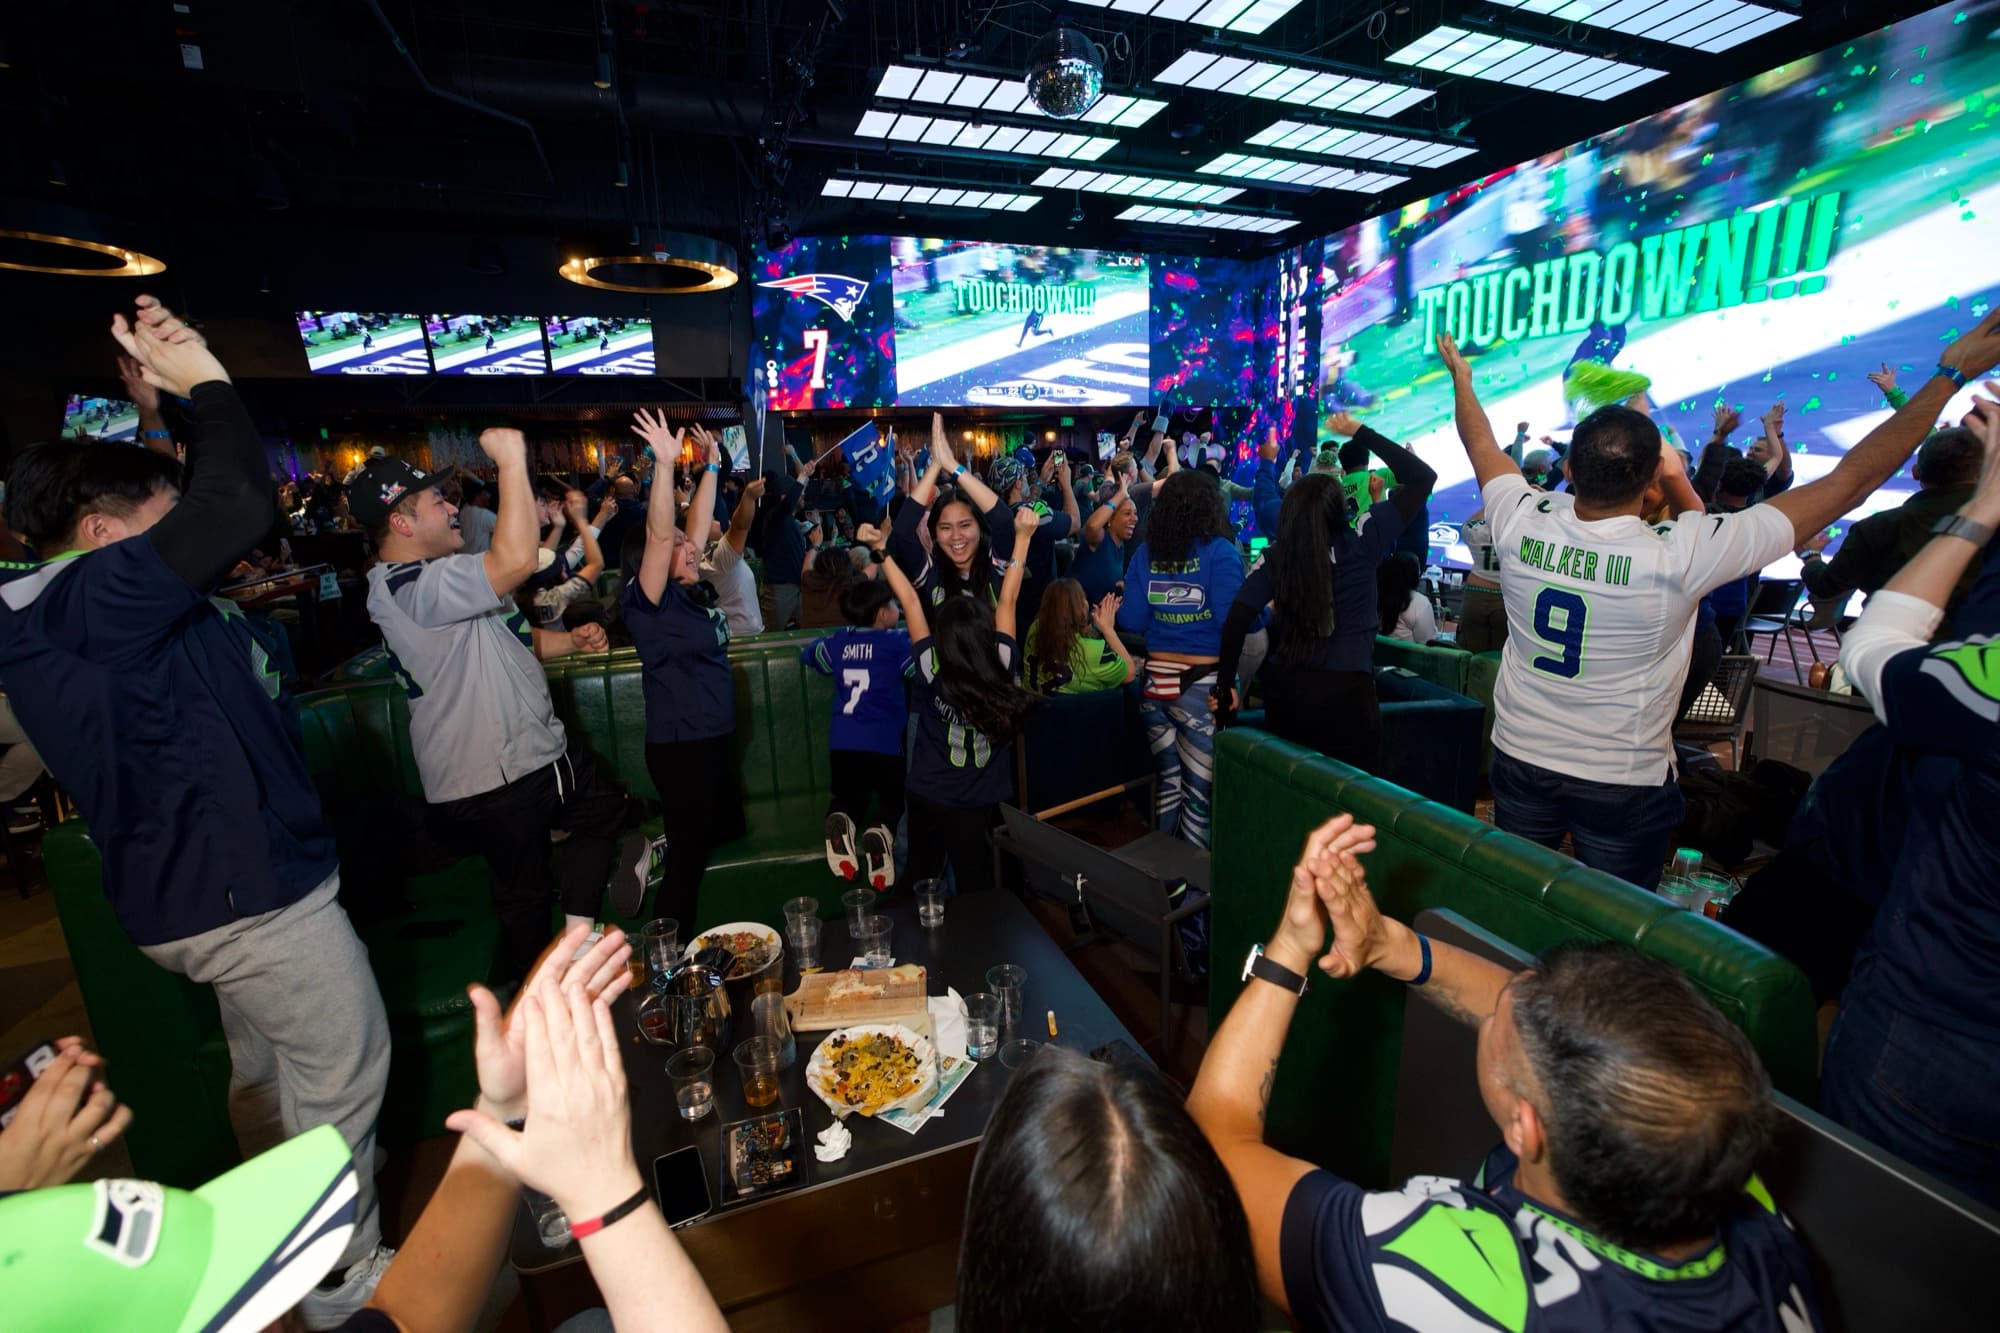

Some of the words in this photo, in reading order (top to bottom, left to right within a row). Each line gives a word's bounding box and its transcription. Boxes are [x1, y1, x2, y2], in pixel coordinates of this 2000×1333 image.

[952, 279, 1096, 315] TOUCHDOWN!!!
[1418, 191, 1841, 355] TOUCHDOWN!!!
[803, 329, 828, 389] 7
[1519, 535, 1599, 582] WALKER
[1605, 554, 1632, 586] III
[842, 642, 874, 661] SMITH
[1531, 582, 1591, 680] 9
[843, 667, 870, 715] 7
